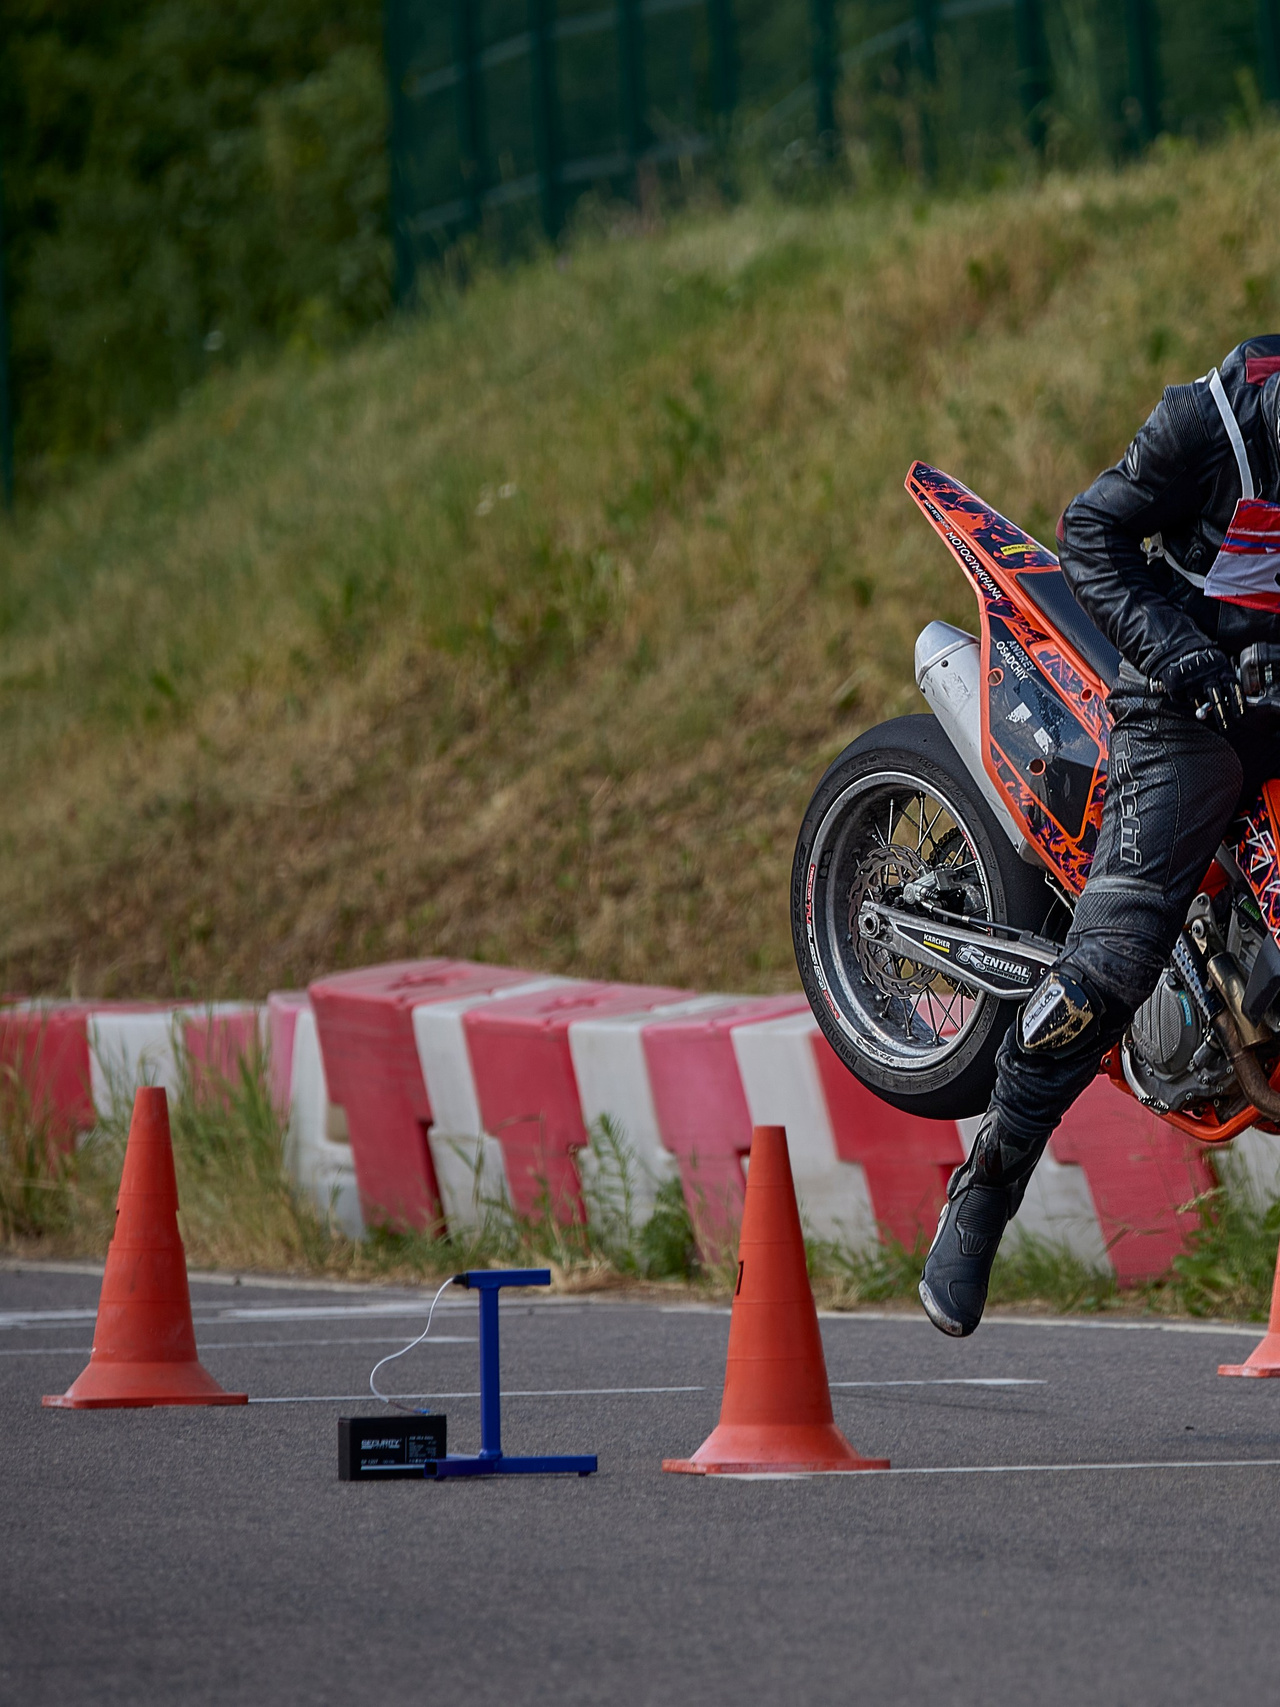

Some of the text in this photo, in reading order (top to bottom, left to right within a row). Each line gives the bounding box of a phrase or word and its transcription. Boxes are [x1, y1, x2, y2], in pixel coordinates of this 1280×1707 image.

[945, 531, 1003, 600] MOTOGYMKHANA
[996, 641, 1028, 681] OSADCHIY
[1007, 640, 1037, 671] ANDREY
[956, 944, 1031, 978] RENTHAL
